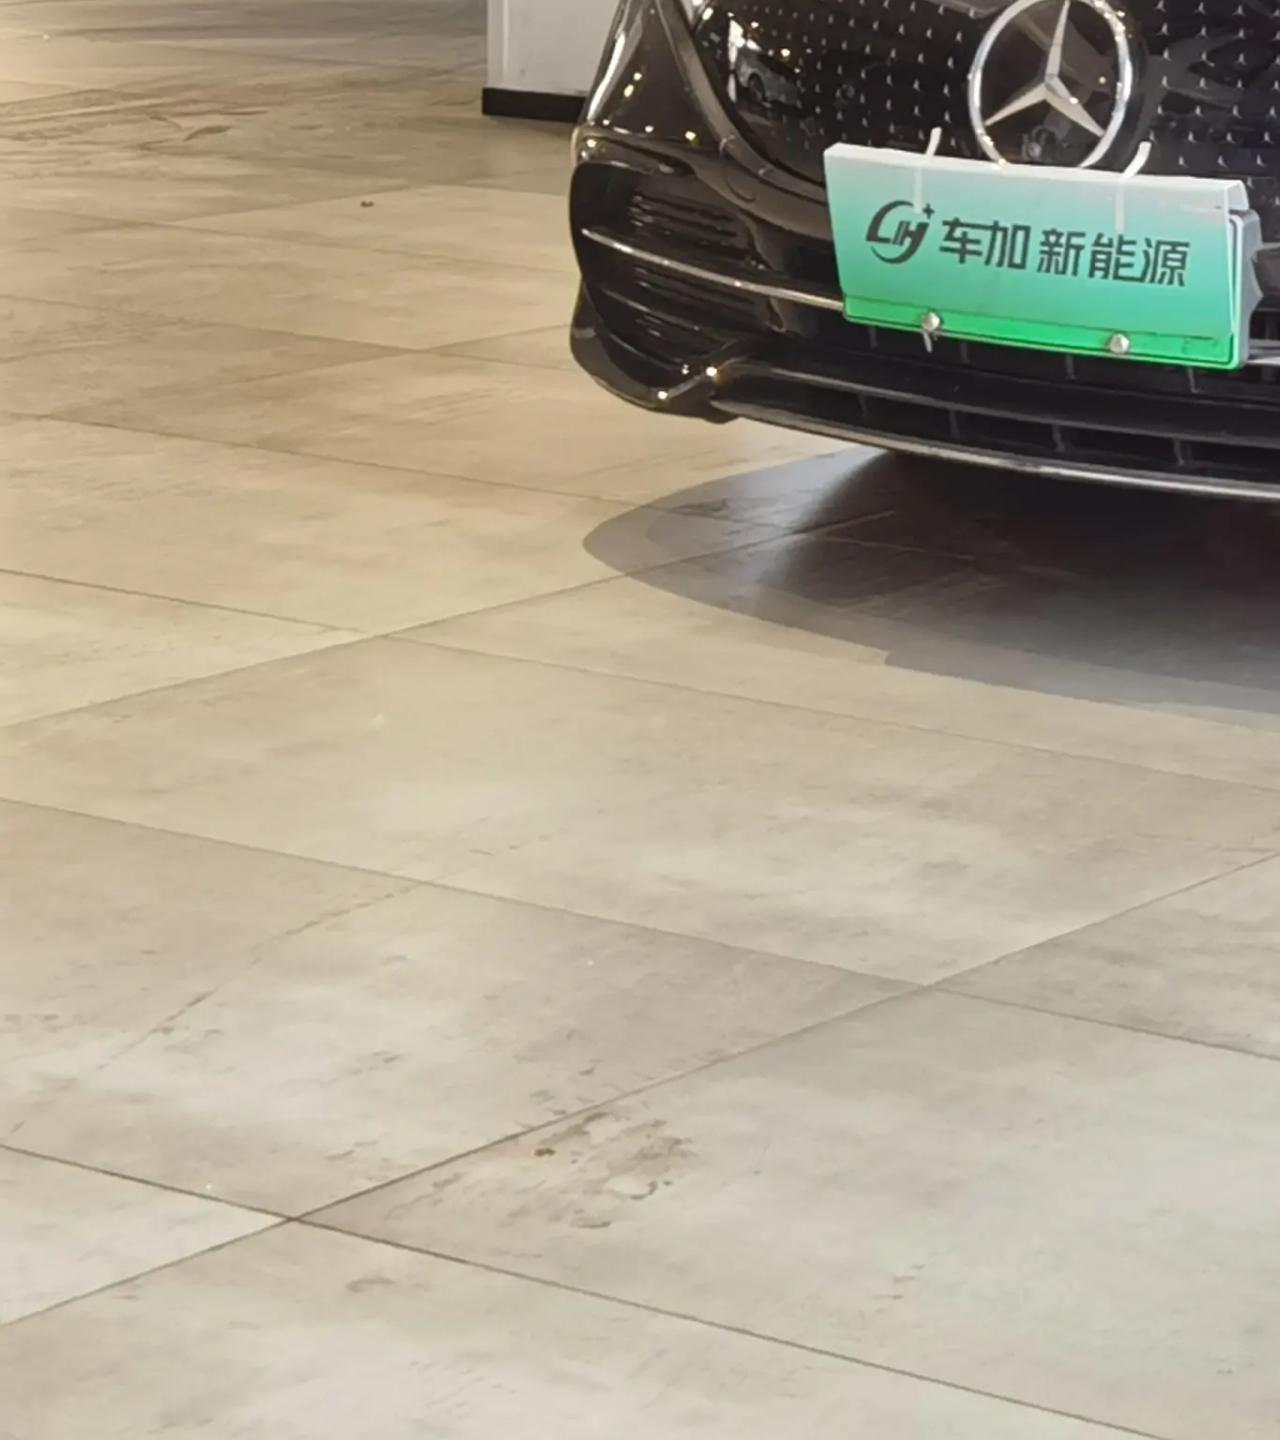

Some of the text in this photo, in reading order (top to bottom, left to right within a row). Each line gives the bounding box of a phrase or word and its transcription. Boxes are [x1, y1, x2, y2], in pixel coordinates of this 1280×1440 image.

[938, 217, 1190, 287] 车加新能源
